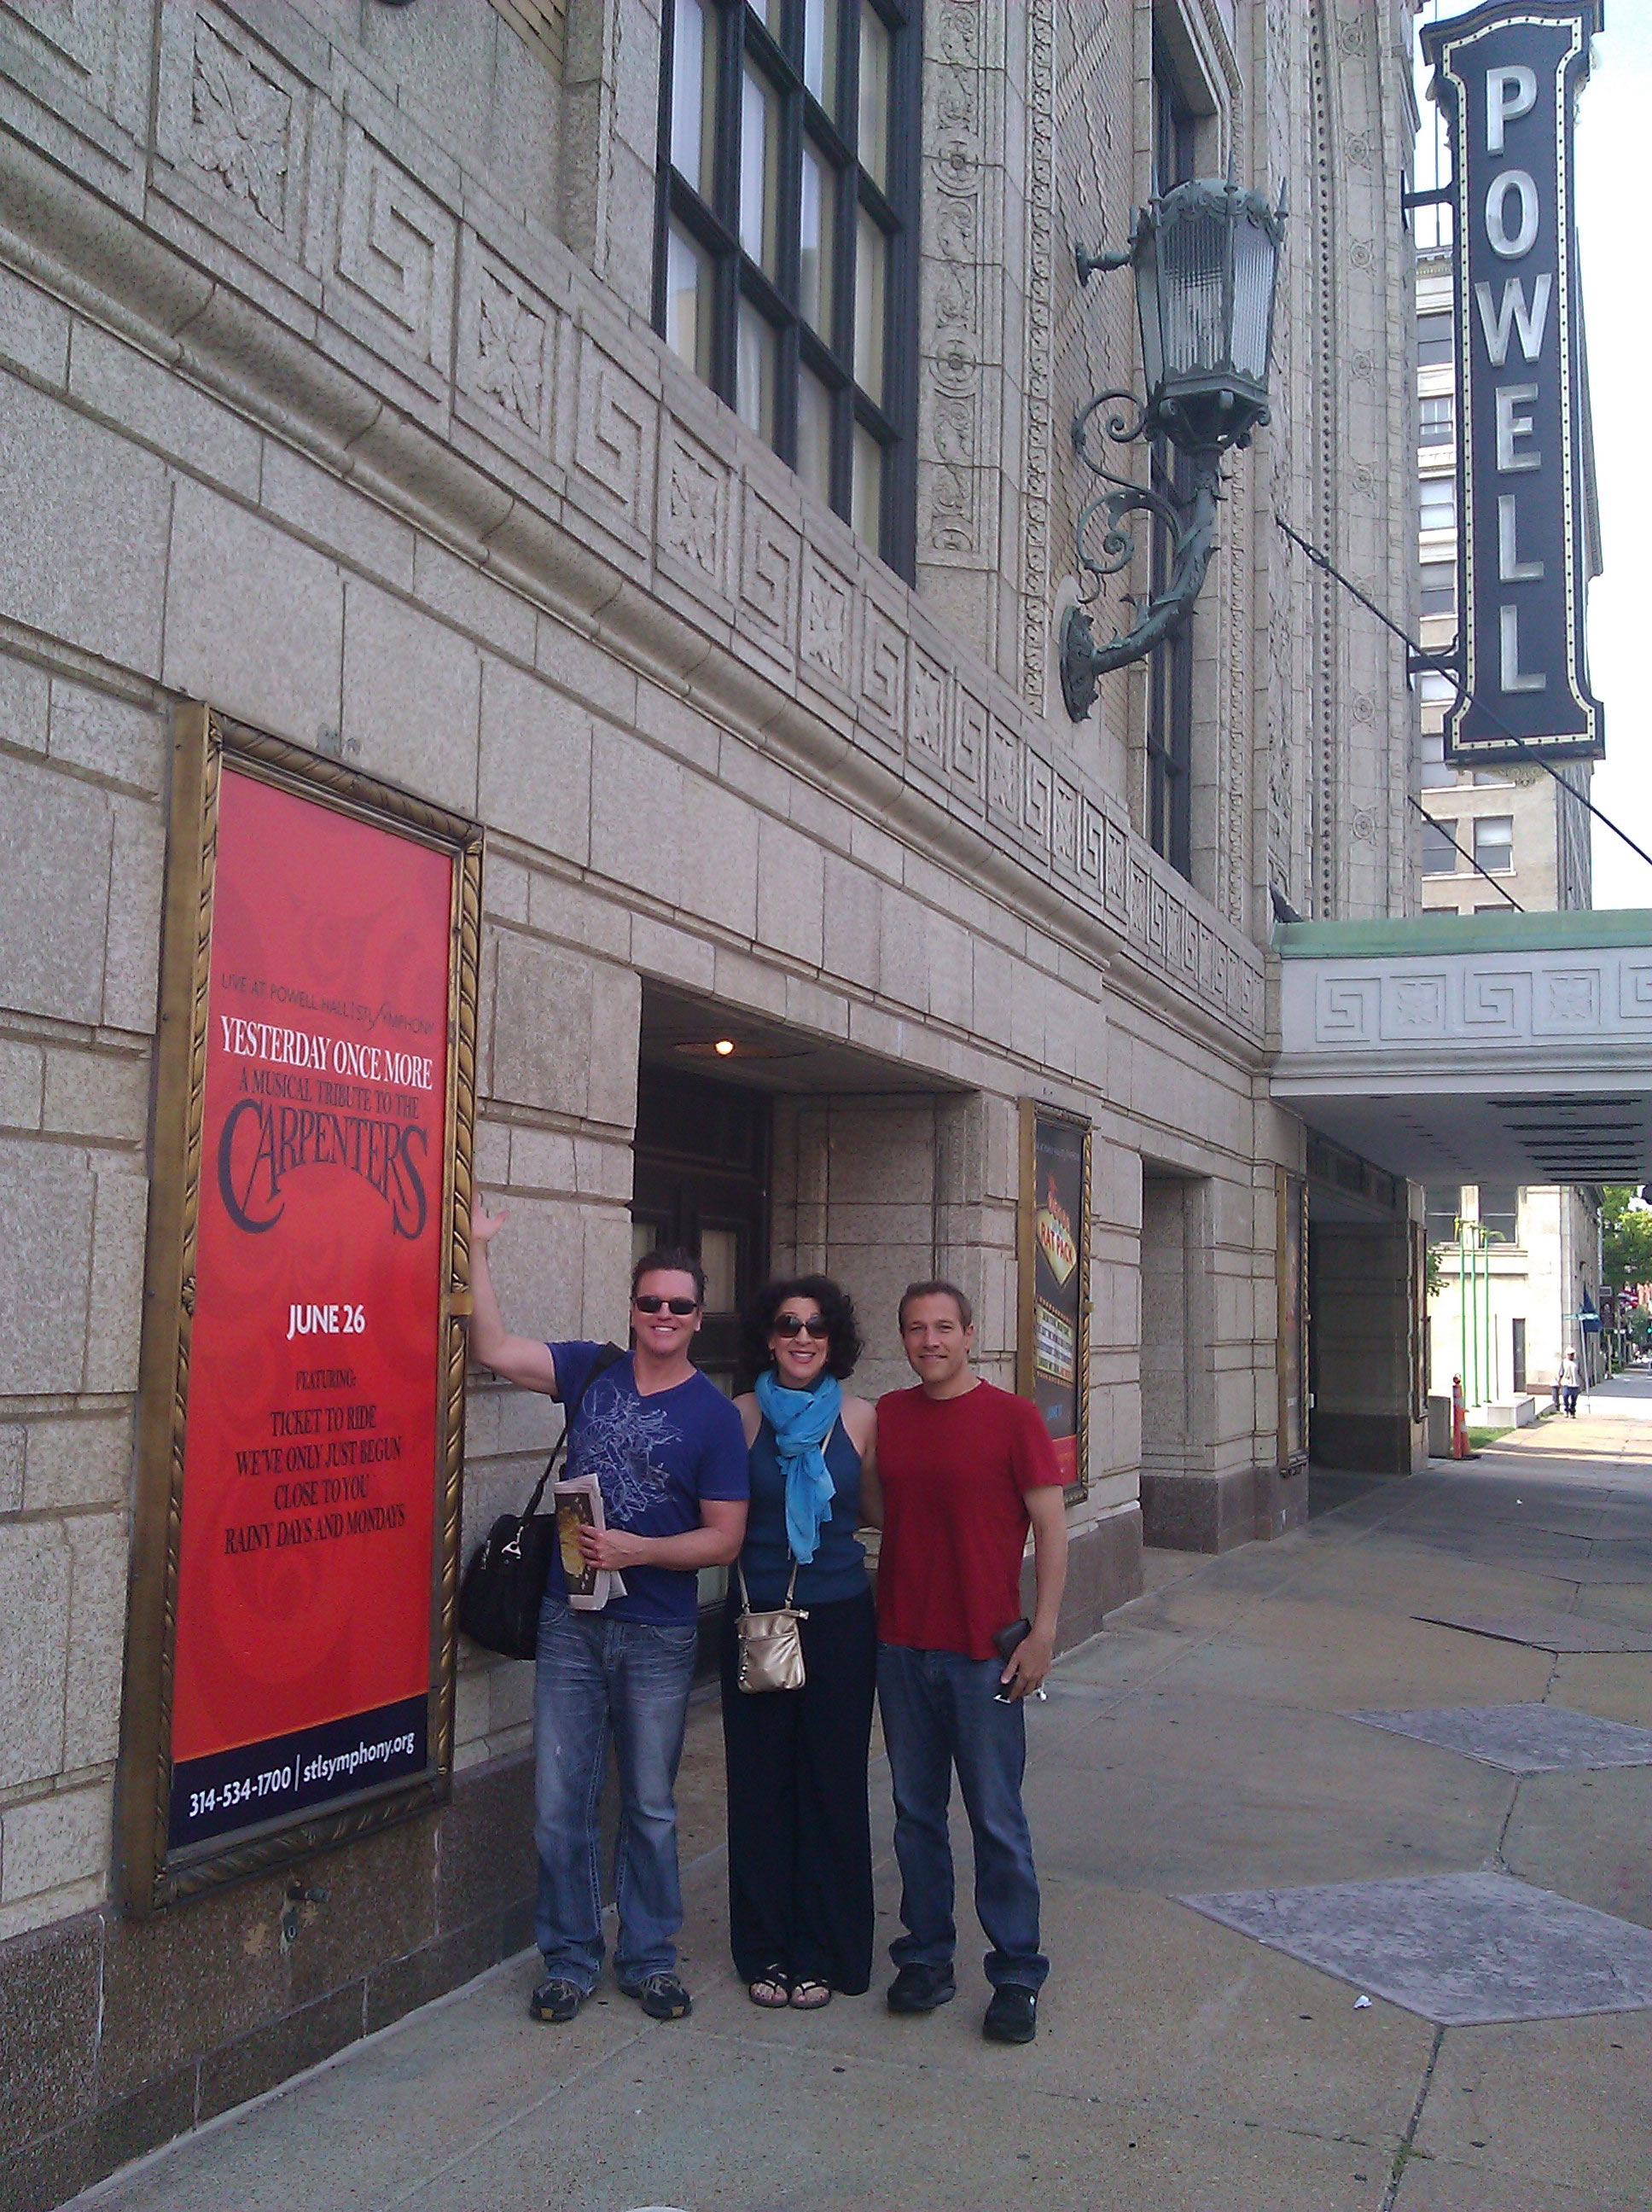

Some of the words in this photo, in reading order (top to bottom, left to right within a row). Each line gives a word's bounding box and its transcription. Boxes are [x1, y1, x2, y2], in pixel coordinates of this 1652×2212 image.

[1475, 65, 1552, 694] POWELL
[222, 973, 246, 992] LIVE
[252, 980, 266, 997] AT
[270, 984, 317, 1010] POWELL
[321, 995, 348, 1016] HALL
[221, 1016, 333, 1072] YESTERDAY
[334, 1041, 381, 1083] ONCE
[385, 1051, 433, 1090] MORE
[240, 1067, 248, 1091] A
[249, 1070, 311, 1102] MUSICAL
[317, 1079, 371, 1112] TRIBUTE
[375, 1090, 391, 1115] TO
[394, 1092, 419, 1120] THE
[218, 1099, 428, 1239] CARPENTERS
[1040, 1222, 1055, 1252] RAT
[1057, 1235, 1073, 1266] PACK
[287, 1304, 339, 1341] JUNE
[343, 1304, 365, 1334] 26
[295, 1368, 357, 1391] FEATURING:
[270, 1408, 324, 1437] TICKET
[325, 1407, 344, 1433] TO
[346, 1405, 376, 1429] RIDE
[236, 1447, 283, 1476] WE'VE
[286, 1444, 323, 1471] ONLY
[325, 1440, 358, 1468] JUST
[360, 1435, 403, 1464] BEGUN
[274, 1481, 318, 1511] CLOSE
[323, 1478, 341, 1504] TO
[341, 1474, 370, 1501] YOU
[224, 1523, 272, 1555] RAINY
[276, 1516, 312, 1548] DAYS
[314, 1512, 344, 1541] AND
[346, 1503, 405, 1535] MONDAYS
[189, 1766, 292, 1819] 314-534-1700
[303, 1732, 416, 1783] stlsymphony.org
